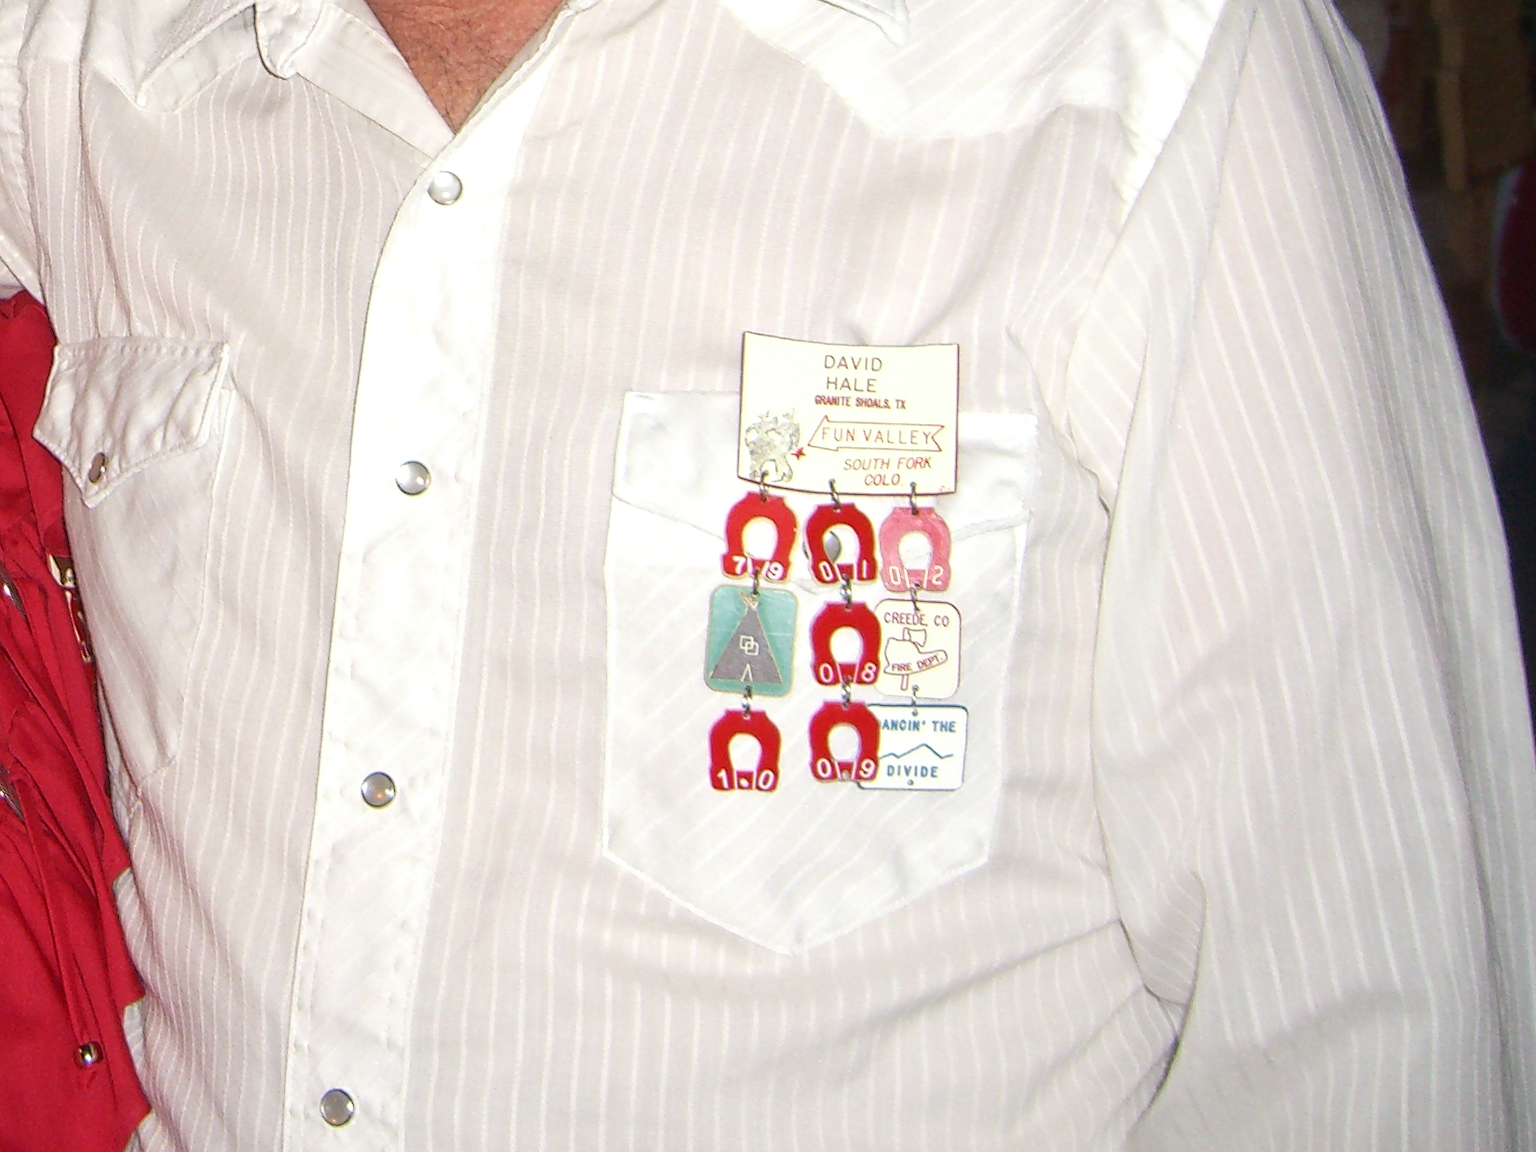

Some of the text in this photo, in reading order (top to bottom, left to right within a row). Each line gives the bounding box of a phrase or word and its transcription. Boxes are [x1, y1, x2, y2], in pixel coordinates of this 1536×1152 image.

[824, 354, 883, 373] DAVID
[826, 376, 877, 394] HALE
[814, 394, 851, 408] GRANITE
[895, 398, 907, 410] TX
[821, 426, 932, 446] FUN VALLEY
[843, 456, 932, 472] SOUTH FORK
[933, 614, 950, 628] CO
[891, 661, 913, 673] FIRE
[879, 719, 957, 734] ANCIN' THE
[885, 764, 939, 778] DIVIDE
